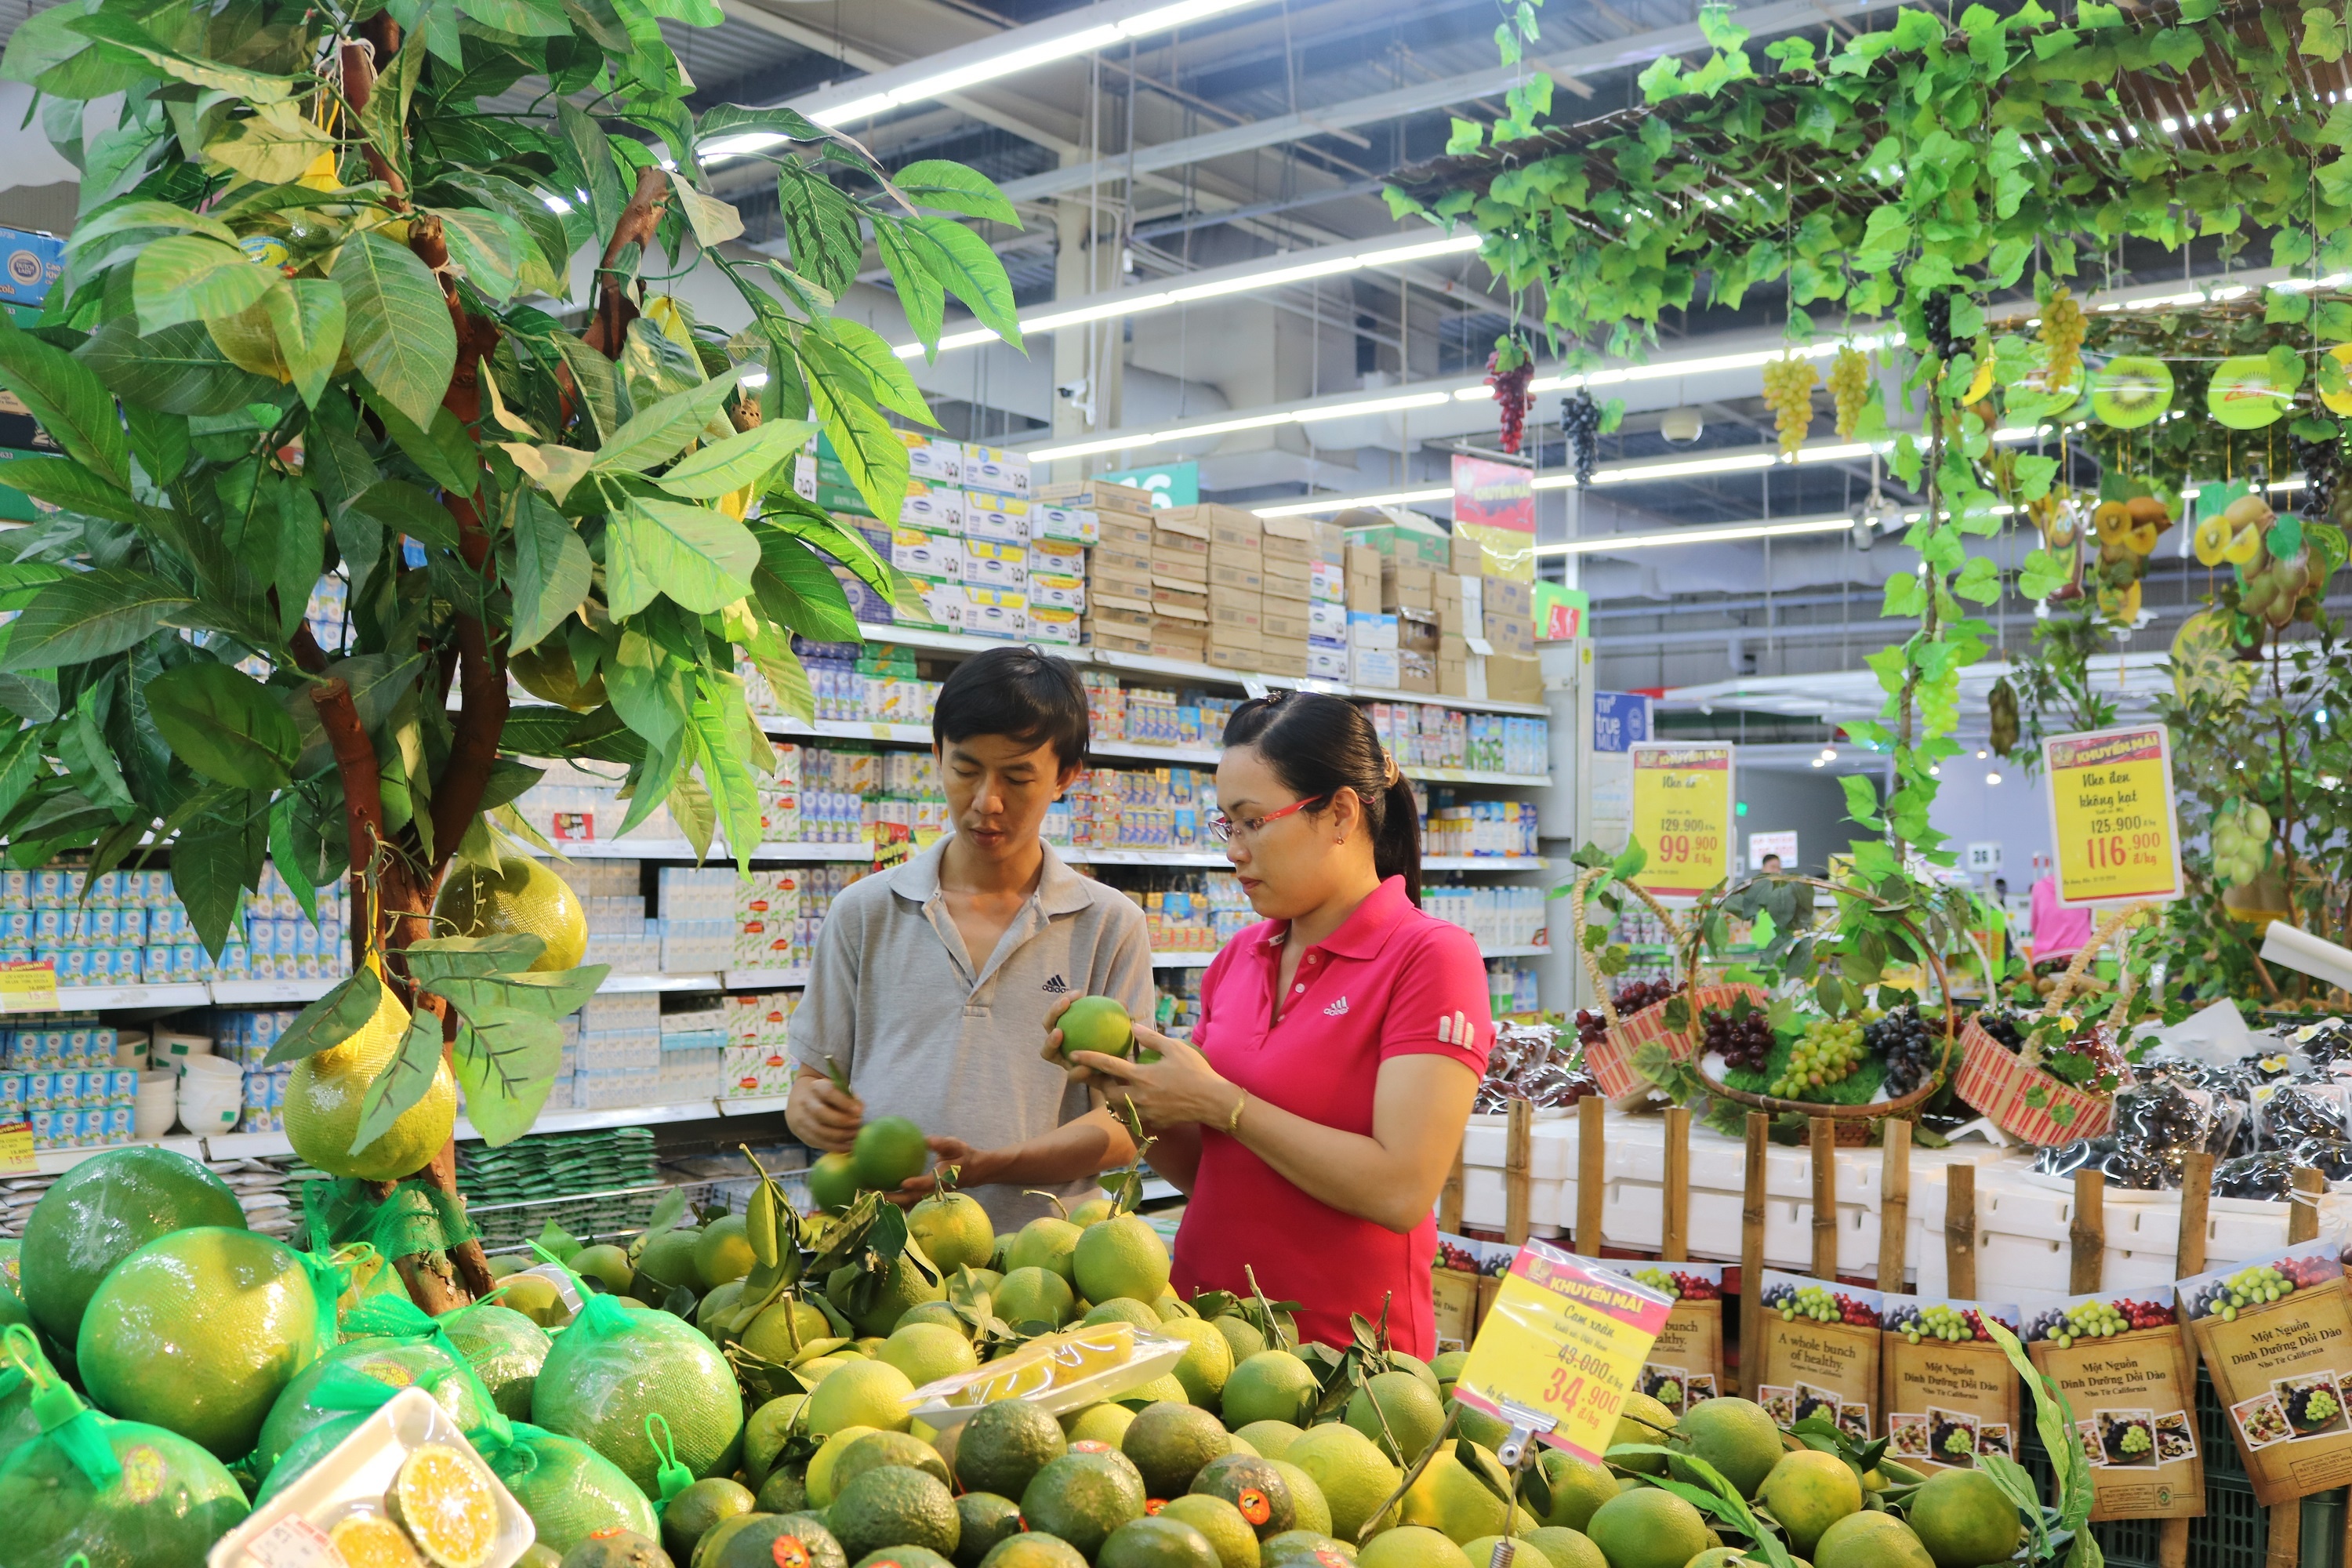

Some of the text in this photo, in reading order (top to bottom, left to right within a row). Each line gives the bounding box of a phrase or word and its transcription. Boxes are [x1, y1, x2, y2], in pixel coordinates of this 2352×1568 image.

[1595, 713, 1621, 735] true
[1596, 734, 1621, 750] MILK
[2076, 741, 2130, 763] KHUYẾN
[2109, 771, 2131, 783] đen
[1661, 818, 1704, 831] 129.900
[2091, 816, 2141, 834] 125.900
[1550, 1276, 1644, 1313] KHUYẾN MÃI
[1564, 1305, 1615, 1338] Cam xoàn
[1665, 1319, 1698, 1333] bunch
[2251, 1319, 2310, 1344] Một Nguồn
[1654, 1332, 1687, 1348] ealthy.
[1778, 1333, 1857, 1358] A whole bunch
[2231, 1328, 2343, 1365] Dinh Dưỡng Dồi Dào
[1558, 1344, 1610, 1380] 43.000
[1791, 1349, 1845, 1372] of healthy.
[2082, 1356, 2139, 1374] Một Nguồn
[2258, 1359, 2274, 1370] Nho
[2287, 1346, 2325, 1362] California
[1925, 1362, 1974, 1376] Một Nguồn
[1904, 1372, 1925, 1384] Dinh
[1928, 1375, 1958, 1388] Dưỡng
[1980, 1381, 1998, 1392] Dào
[2060, 1370, 2166, 1389] Dinh Dưỡng Dồi Dào
[1947, 1390, 1979, 1399] California
[2112, 1386, 2147, 1395] California
[1577, 1406, 1600, 1430] đ/kg
